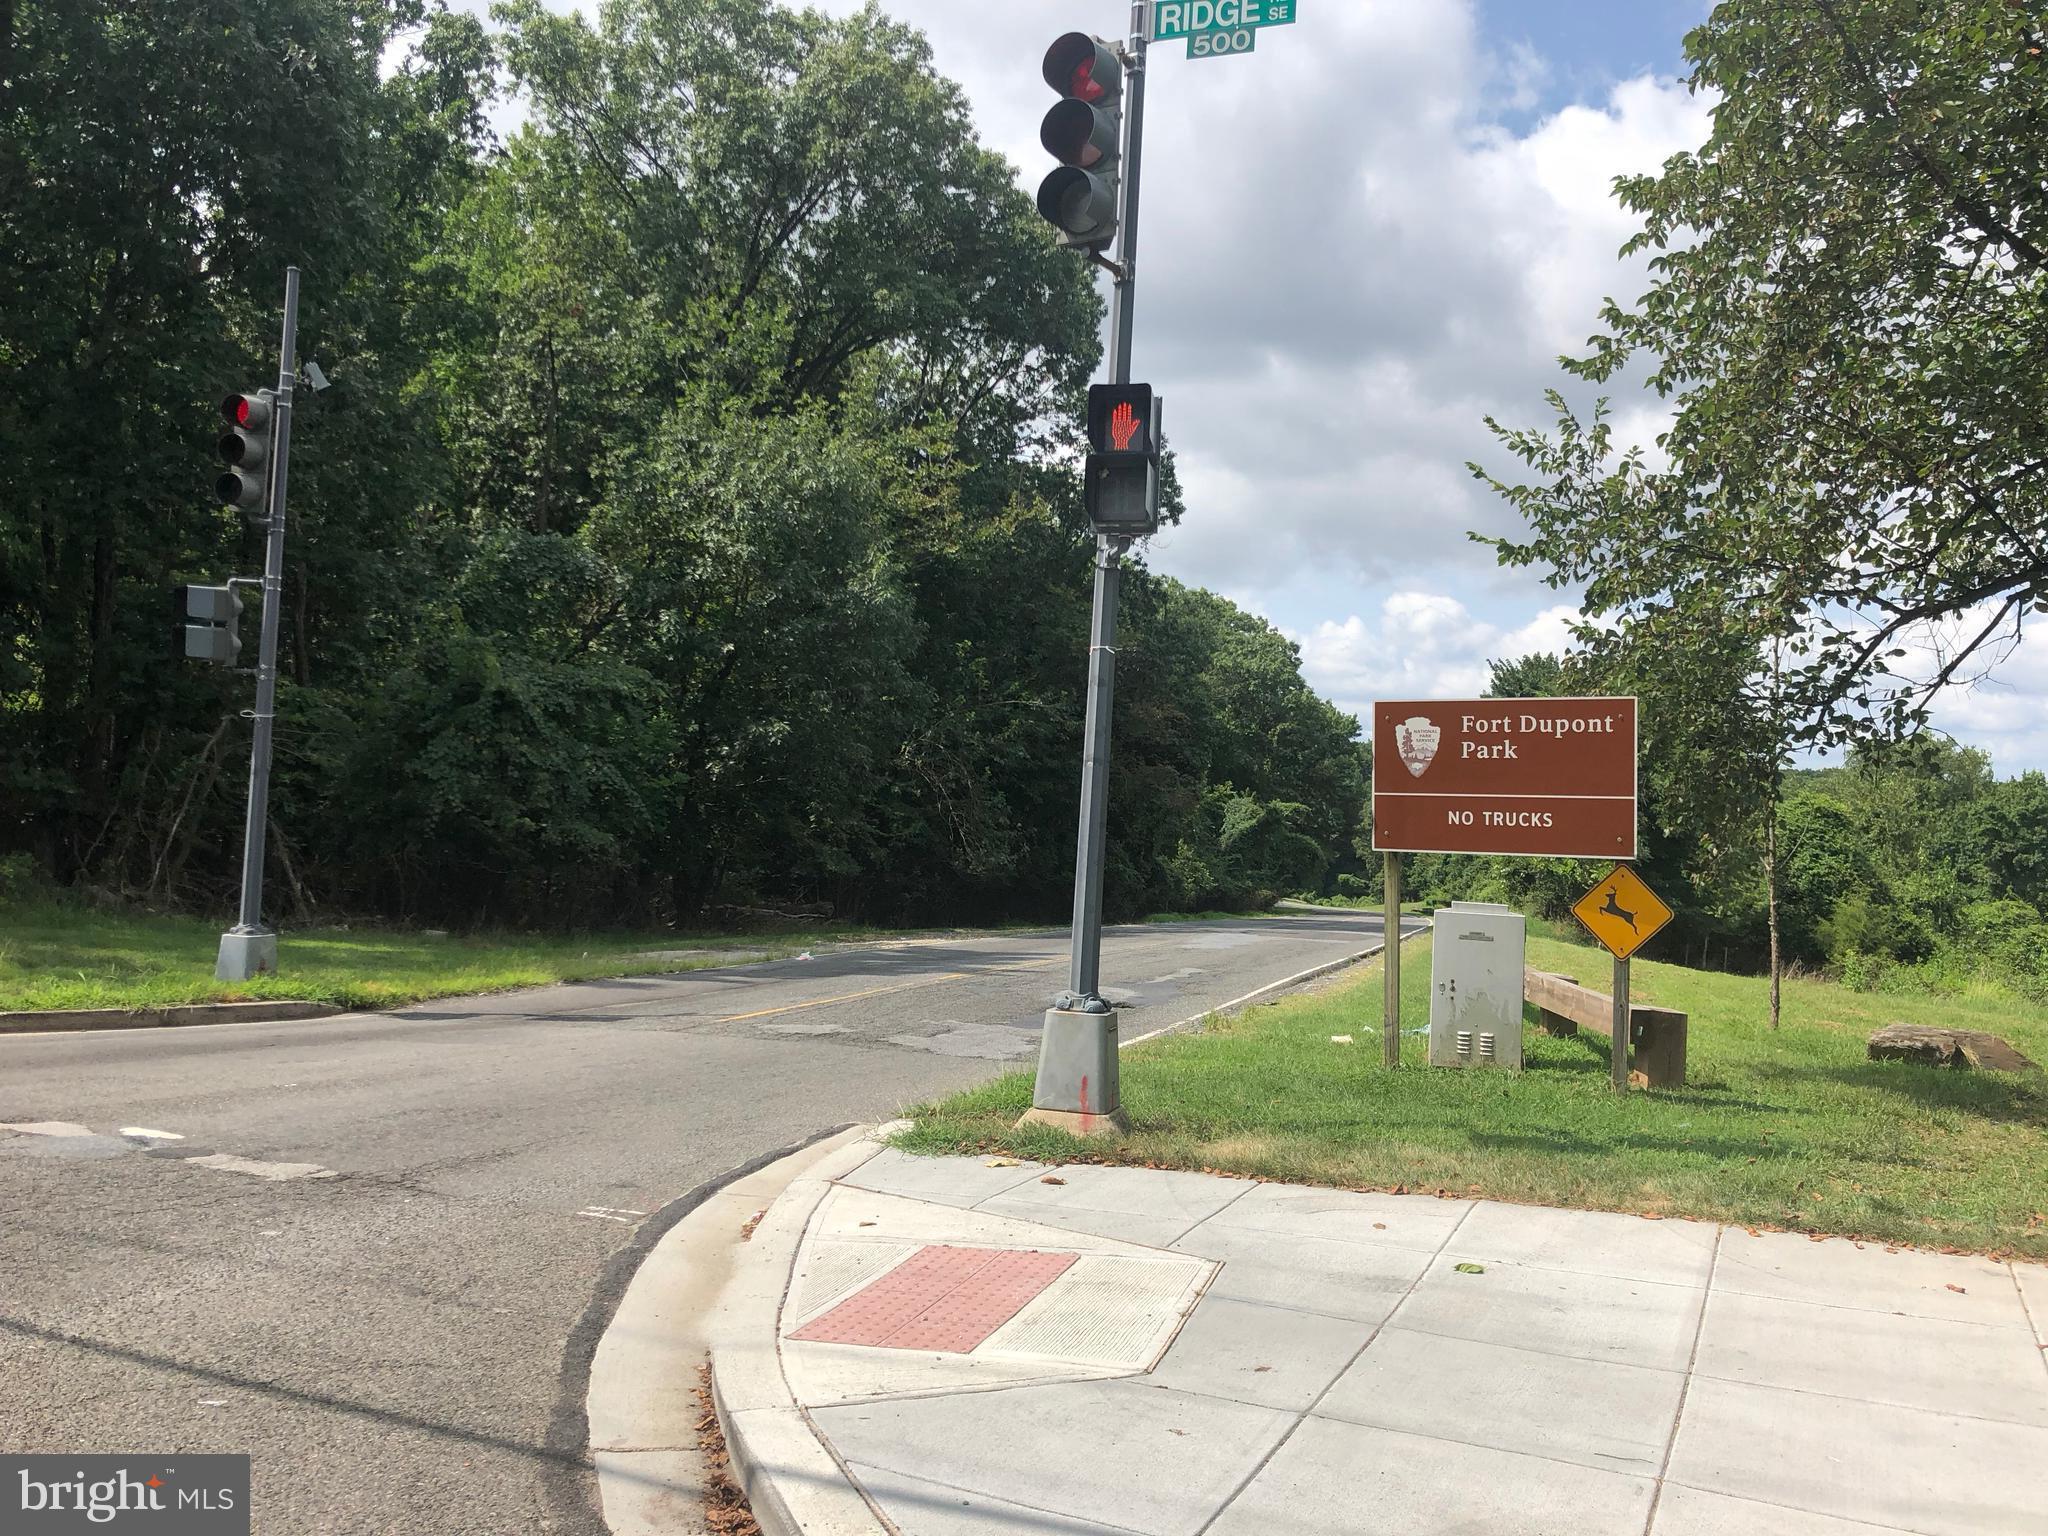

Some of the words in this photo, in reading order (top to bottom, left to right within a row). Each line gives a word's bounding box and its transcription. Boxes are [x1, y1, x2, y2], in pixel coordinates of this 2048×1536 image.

[1160, 0, 1260, 34] RIDGE
[1269, 6, 1289, 20] SE
[1192, 30, 1251, 56] 500
[1461, 715, 1512, 733] Fort
[1519, 715, 1614, 738] Dupont
[1461, 740, 1518, 759] Park
[1448, 810, 1474, 826] NO
[1483, 811, 1553, 828] TRUCKS
